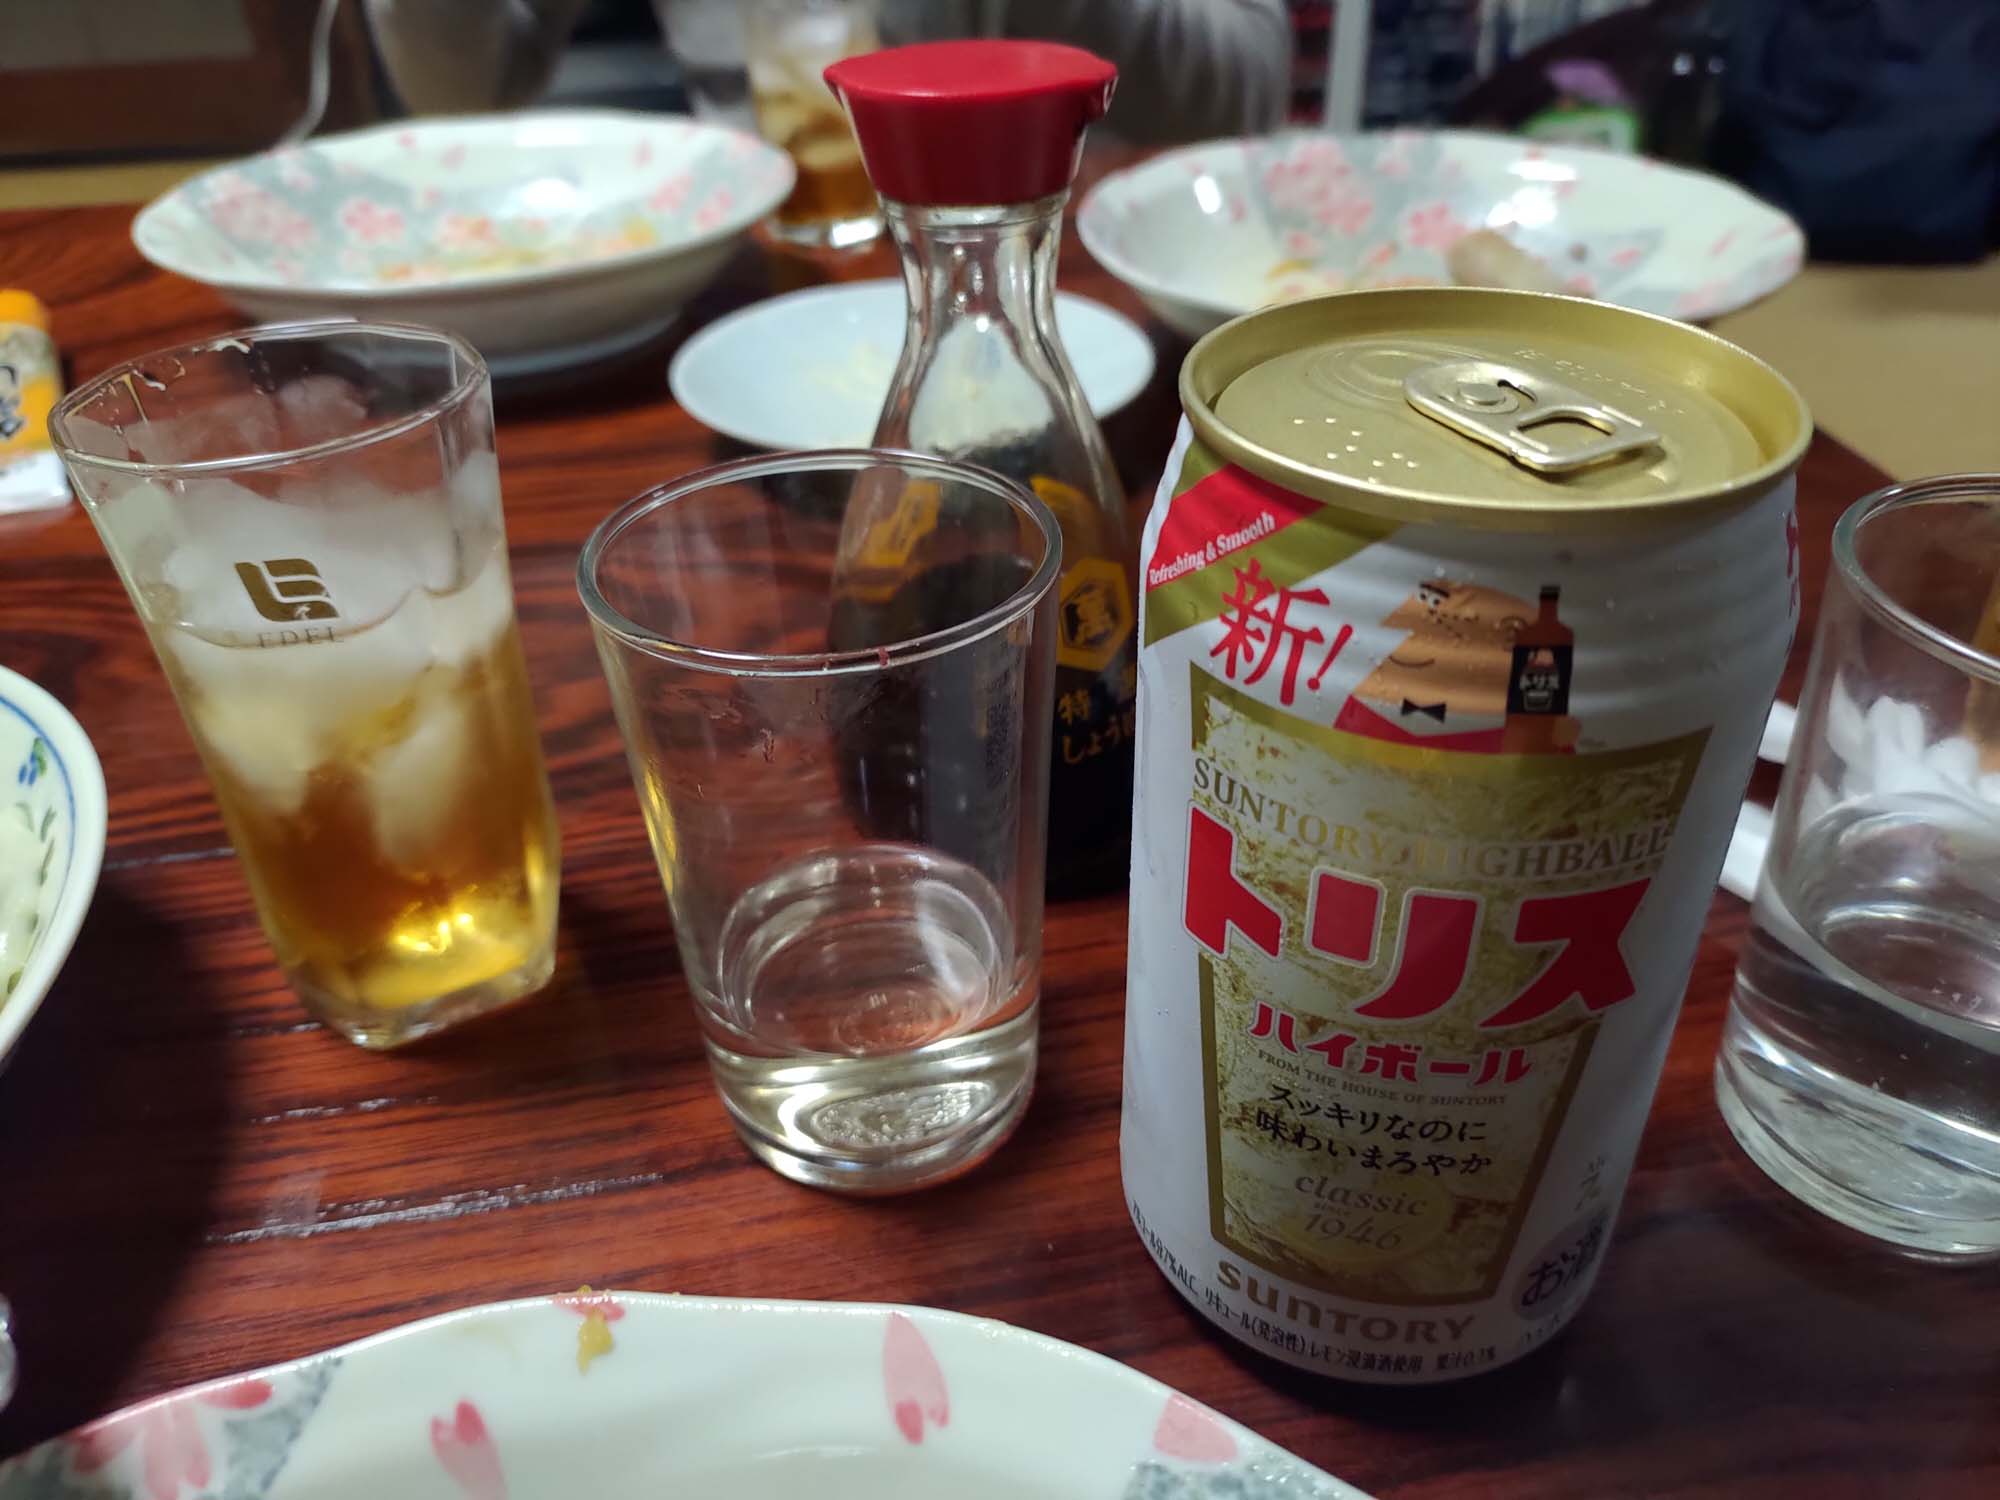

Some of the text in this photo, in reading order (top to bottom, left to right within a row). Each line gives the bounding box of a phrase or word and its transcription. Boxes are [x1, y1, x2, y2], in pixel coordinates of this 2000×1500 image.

[1149, 511, 1275, 585] Refreshing & Smooth
[1209, 556, 1354, 707] 新!
[1194, 757, 1673, 880] SUNTORY HIGHBALL
[1183, 804, 1653, 1030] トリス
[1249, 1001, 1535, 1086] ハイボール
[1257, 1049, 1506, 1106] FROM THE HOUSE OF SUNTORY
[1255, 1109, 1492, 1176] 味わいまろやか
[1270, 1084, 1488, 1142] スッキリなのに
[1295, 1175, 1428, 1217] classic
[1303, 1213, 1408, 1250] 1946
[1216, 1258, 1475, 1344] SUNTORY
